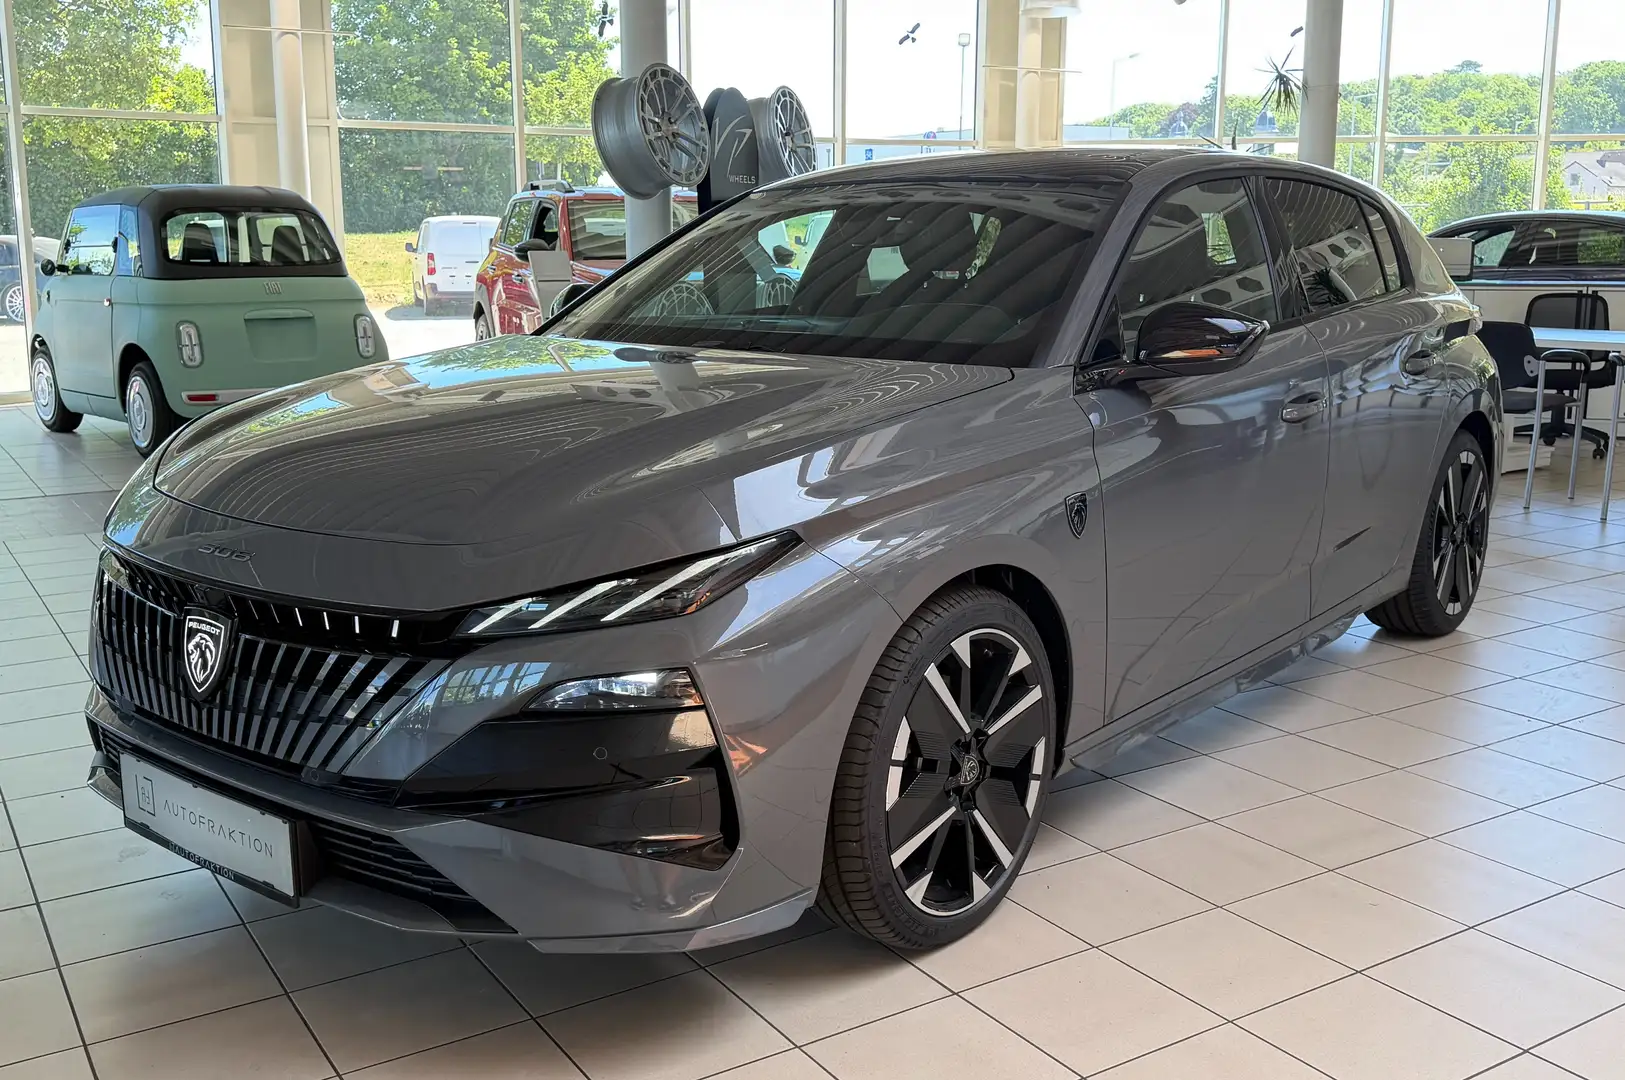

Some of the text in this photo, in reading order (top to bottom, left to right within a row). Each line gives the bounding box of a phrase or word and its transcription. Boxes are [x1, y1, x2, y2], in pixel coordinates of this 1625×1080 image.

[728, 174, 756, 184] WHEELS
[263, 281, 282, 294] FIAT
[188, 620, 221, 636] PEUGEOT
[163, 799, 274, 859] AUTOFRAKTION
[175, 846, 235, 881] AUTOFRAKTION
